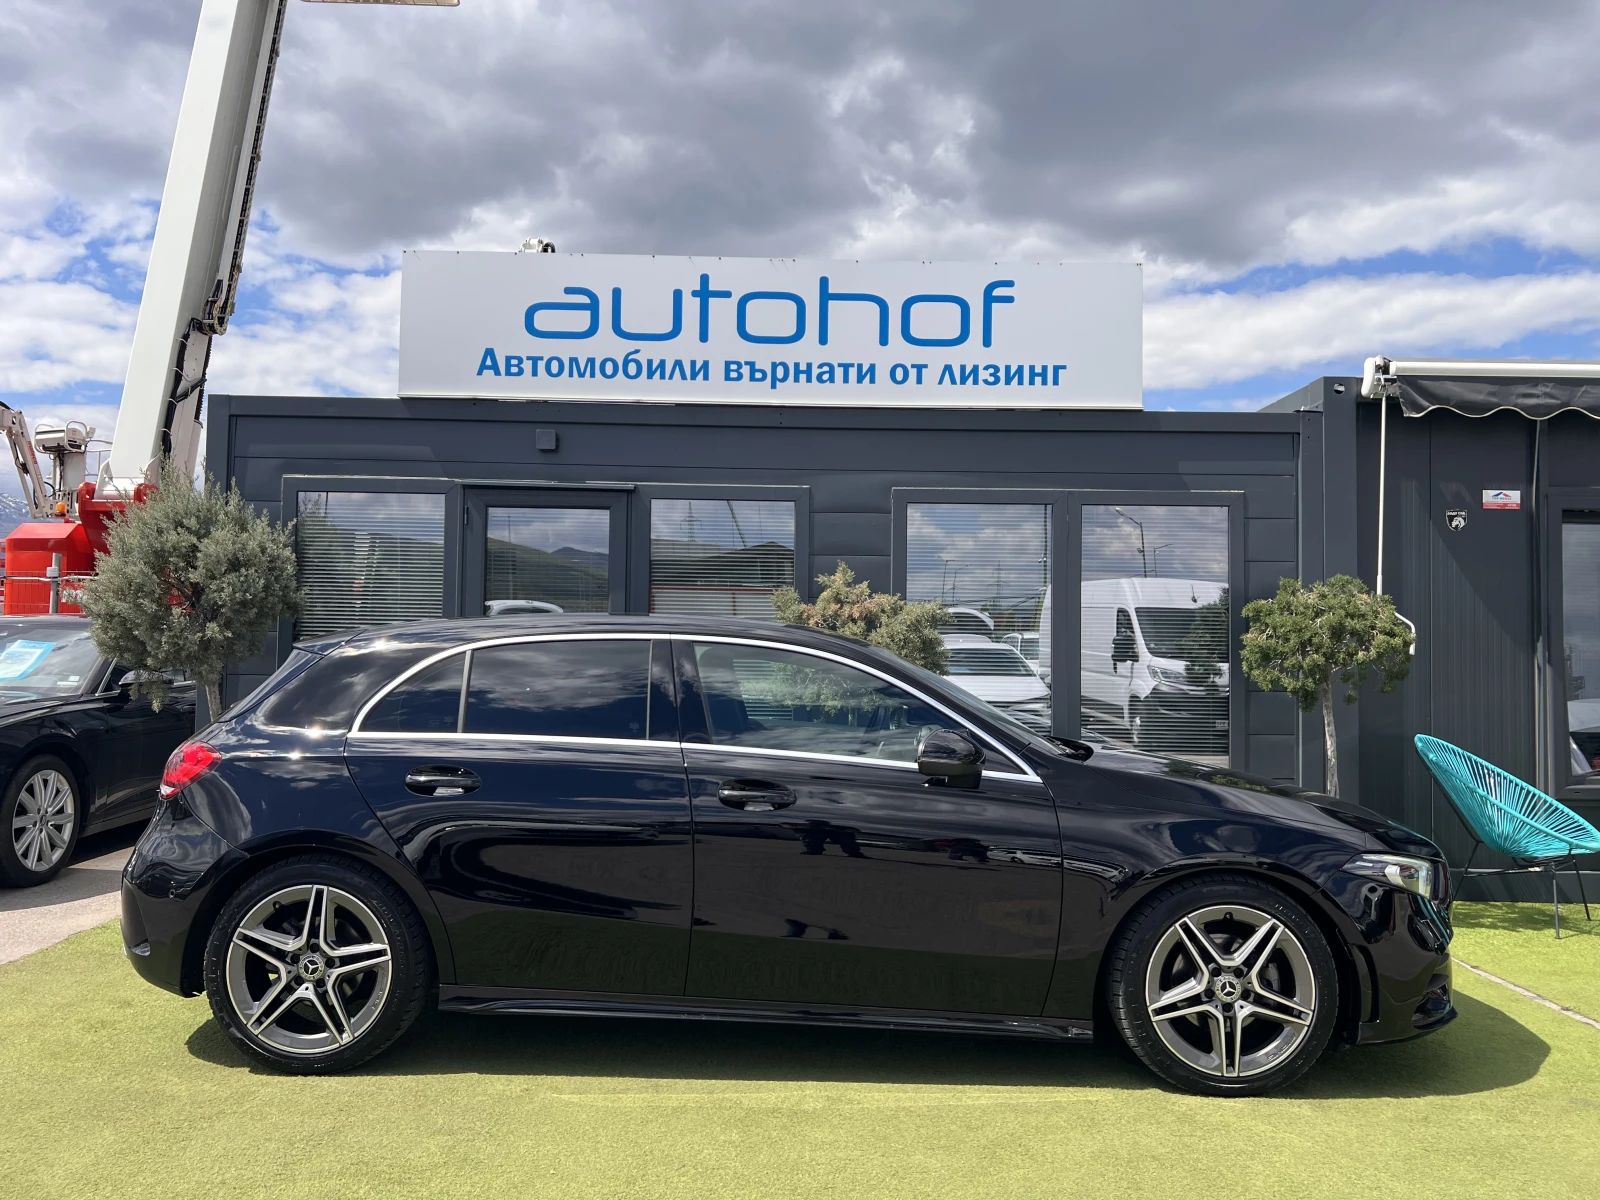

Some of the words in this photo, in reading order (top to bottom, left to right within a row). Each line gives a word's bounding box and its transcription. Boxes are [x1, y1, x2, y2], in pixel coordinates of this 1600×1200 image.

[524, 272, 1016, 349] autohof
[476, 347, 710, 382] Автомобили
[723, 360, 877, 391] върнати
[889, 362, 929, 386] от
[937, 364, 1067, 388] лизинг
